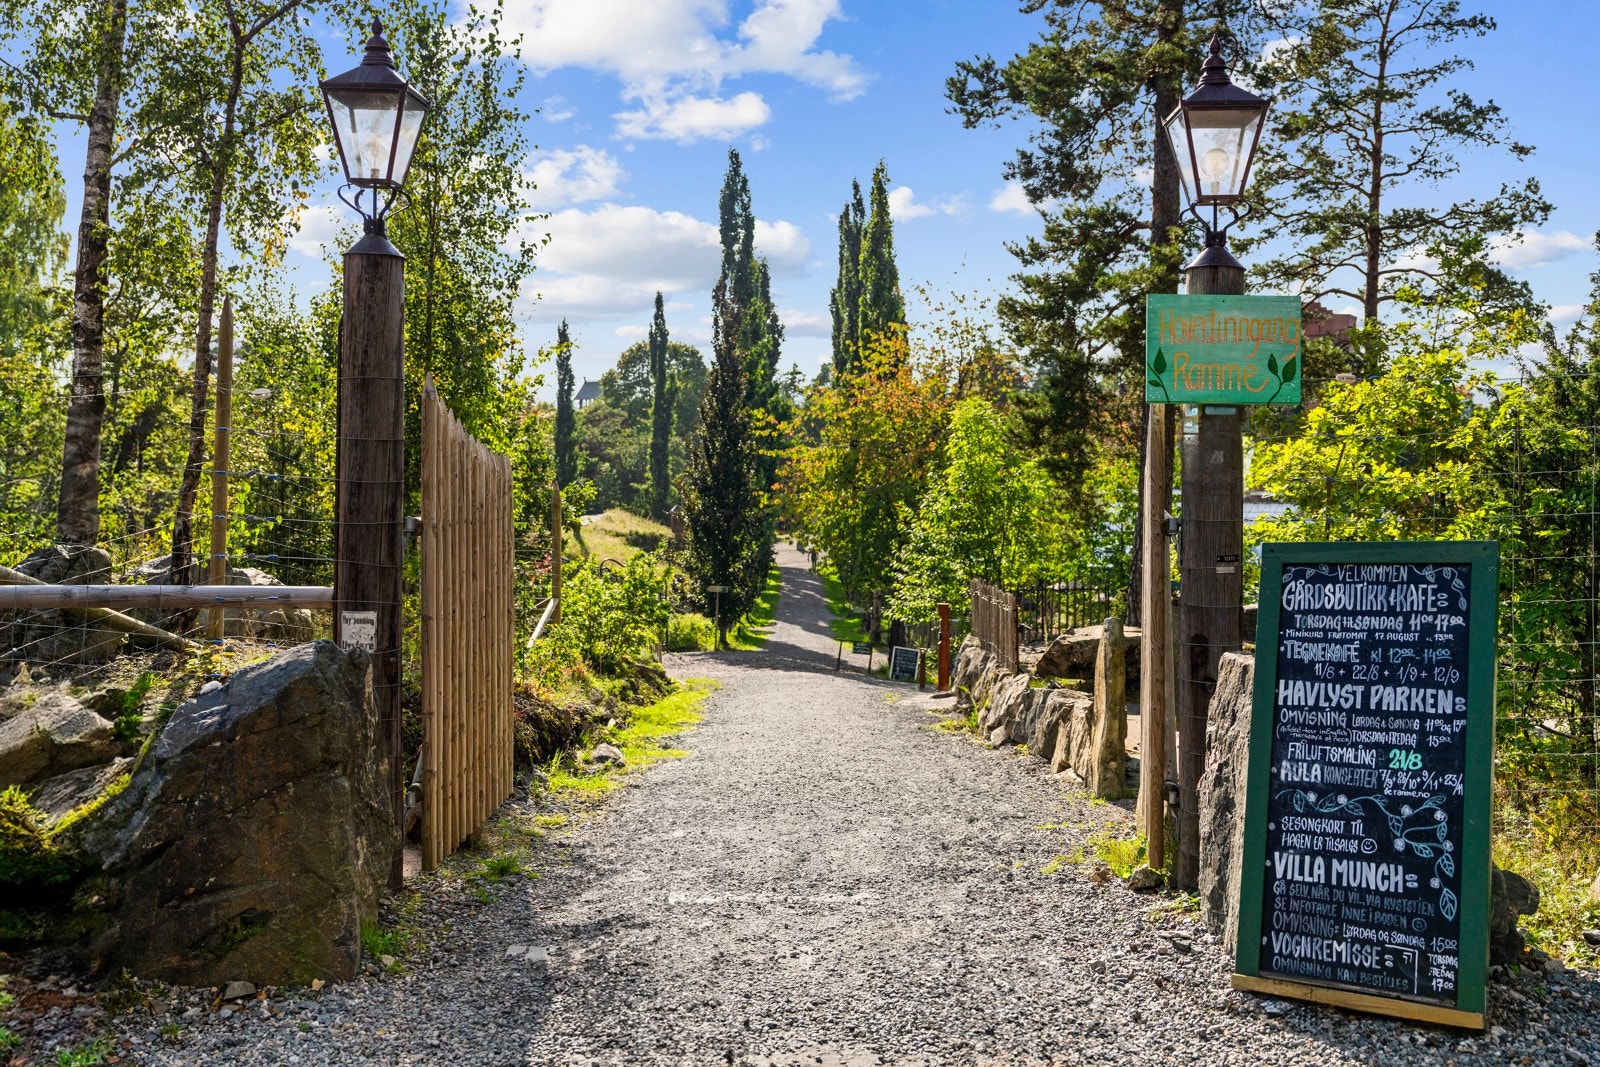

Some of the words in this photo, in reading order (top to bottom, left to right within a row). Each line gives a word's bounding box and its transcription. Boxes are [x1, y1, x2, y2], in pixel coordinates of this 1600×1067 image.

[1159, 307, 1299, 360] Hovedinngang
[1173, 351, 1269, 393] Ramme
[1337, 565, 1408, 582] VELKOMMEN
[1282, 580, 1388, 611] GÅRDSBUTIKK
[1295, 614, 1341, 631] TORSDAG
[1354, 615, 1403, 632] SØNDAG
[1386, 632, 1420, 642] AUGUST
[1284, 640, 1360, 663] TEGNEKAFÉ
[1314, 663, 1335, 679] 11/8
[1352, 665, 1379, 682] 22/8
[1397, 664, 1417, 684] 1/9
[1432, 666, 1460, 685] 12/9
[1278, 680, 1365, 709] HAVLYST
[1280, 707, 1347, 730] OMVISNING
[1352, 713, 1380, 729] LØRDAG
[1388, 716, 1420, 730] SØNDAG
[1351, 729, 1385, 744] TORSDAG
[1389, 731, 1417, 748] FREDAG
[1287, 740, 1377, 768] FRILUFTSMALING
[1389, 749, 1422, 770] 21/8
[1280, 760, 1321, 783] AULA
[1323, 765, 1378, 789] KONSERTER
[1281, 816, 1346, 834] SESONGKORT
[1351, 819, 1365, 836] TIL
[1281, 832, 1312, 849] HAGEN
[1313, 836, 1323, 850] ER
[1274, 850, 1325, 884] VILLA
[1273, 880, 1286, 895] GÅ
[1311, 885, 1330, 900] NÅR
[1333, 889, 1345, 901] DU
[1366, 891, 1380, 908] VIA
[1383, 897, 1435, 917] KYSTSTIEN
[1274, 896, 1287, 910] SE
[1290, 897, 1337, 917] INFOTAVLE
[1341, 903, 1367, 922] INNE
[1374, 911, 1408, 928] BODEN
[1343, 922, 1376, 942] LØRDAG
[1378, 930, 1389, 943] OG
[1391, 931, 1425, 950] SØNDAG
[1272, 956, 1332, 978] OMVISNING
[1337, 968, 1357, 982] KAN
[1360, 972, 1409, 990] BESTILLES
[1427, 953, 1458, 969] TORSDAG
[1428, 967, 1455, 982] FREDAG
